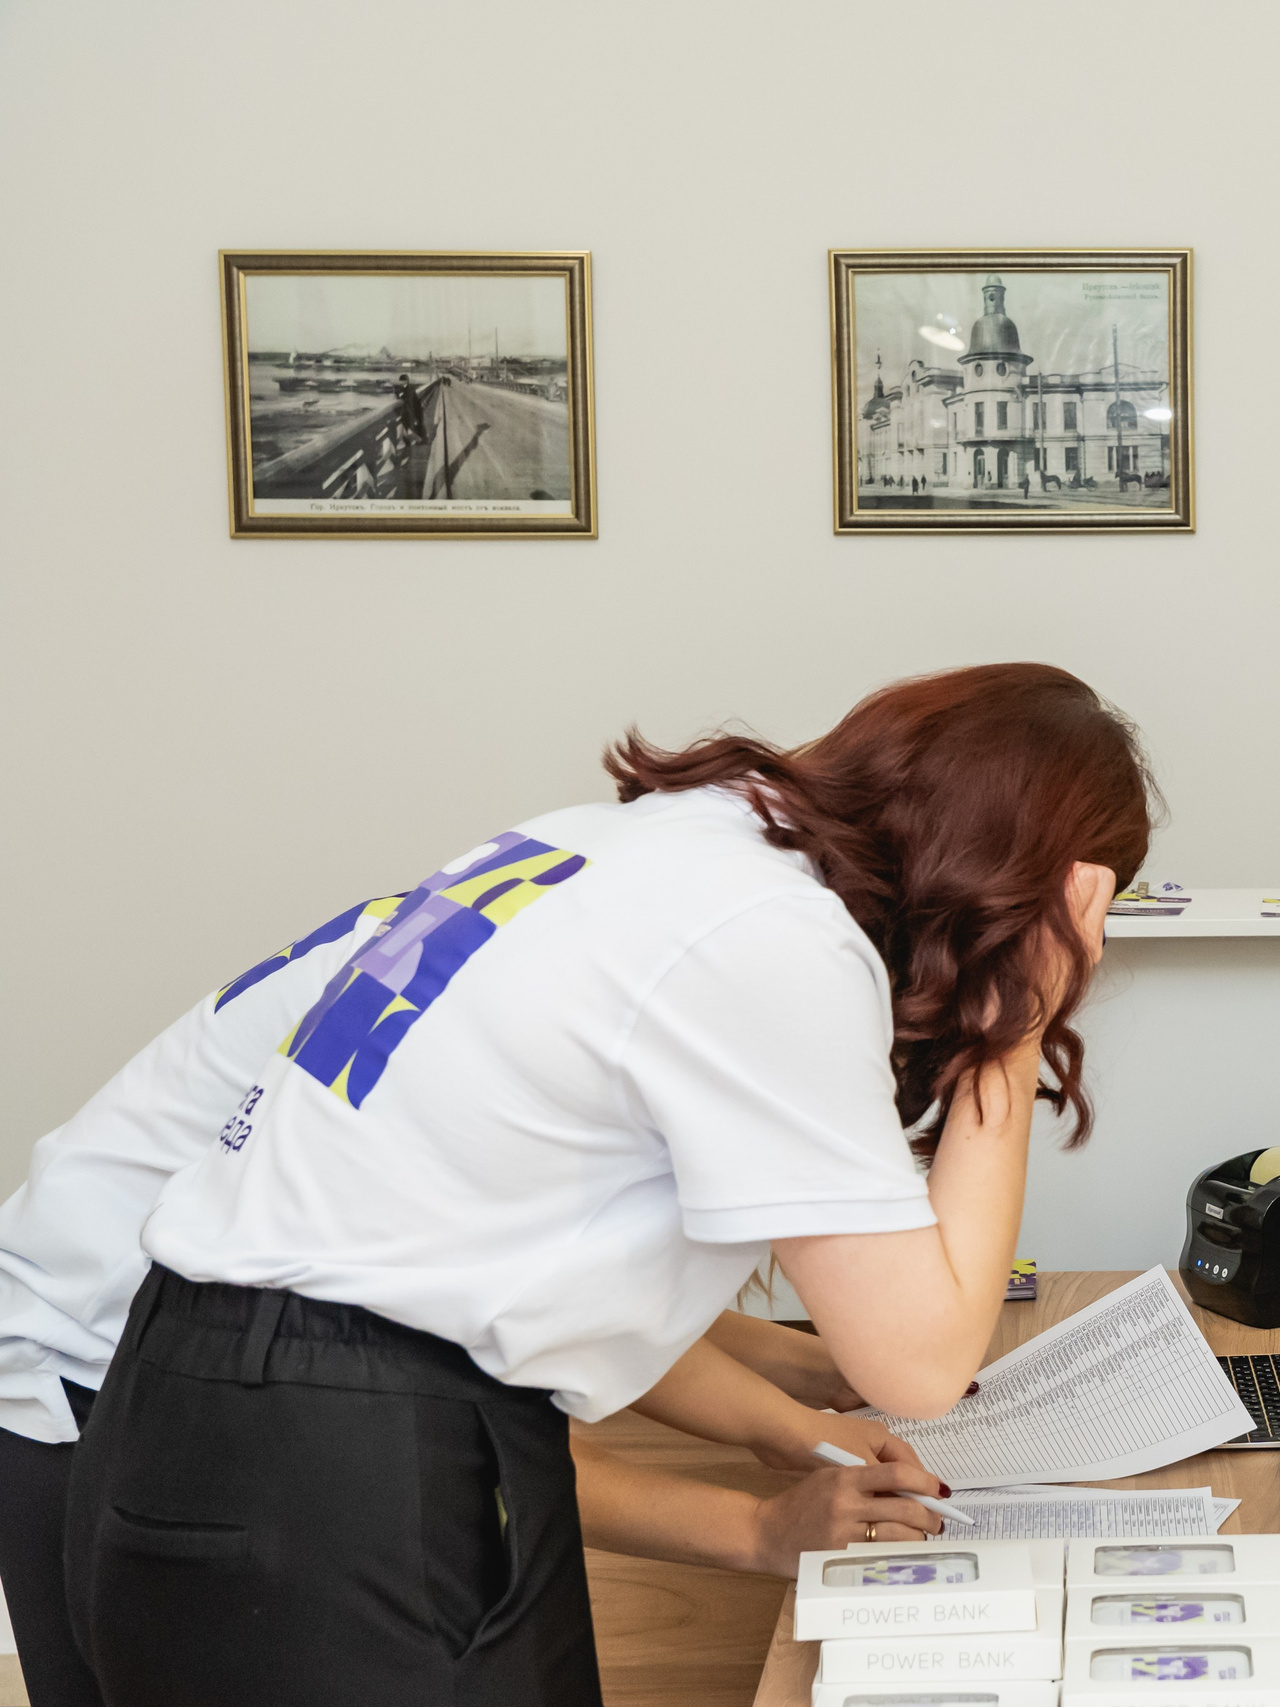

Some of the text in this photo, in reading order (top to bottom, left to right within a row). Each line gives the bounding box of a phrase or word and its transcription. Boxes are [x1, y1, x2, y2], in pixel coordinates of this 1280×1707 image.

[220, 1115, 253, 1155] еда
[842, 1603, 991, 1626] POWER BANK
[866, 1650, 1016, 1671] POWER BANK
